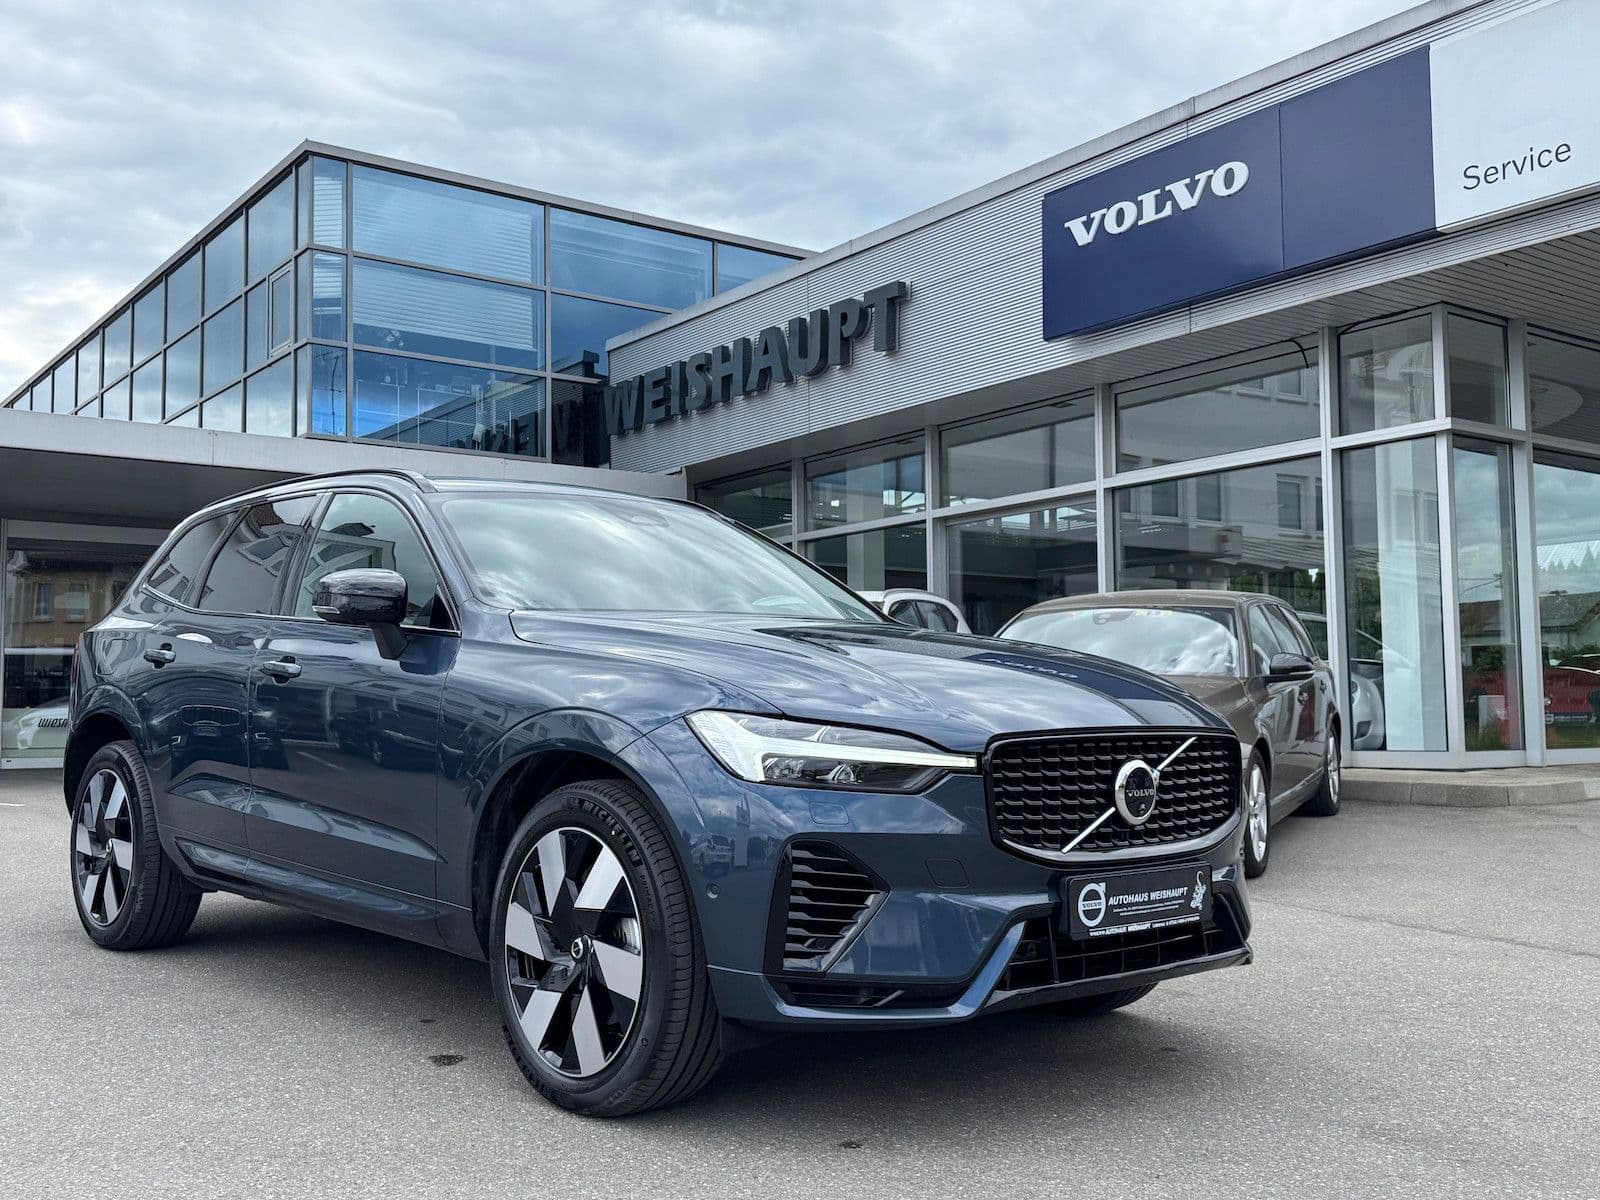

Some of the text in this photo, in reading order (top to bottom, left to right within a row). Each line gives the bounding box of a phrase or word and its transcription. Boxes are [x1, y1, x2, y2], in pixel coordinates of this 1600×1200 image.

[1462, 142, 1571, 191] Service
[1064, 160, 1249, 247] VOLVO
[603, 281, 907, 434] WEISHAUPT
[1126, 788, 1155, 797] VOLVO
[582, 800, 641, 866] MICHELIN
[1108, 893, 1149, 906] AUTOHAUS
[1150, 888, 1188, 901] WEISHAUPT
